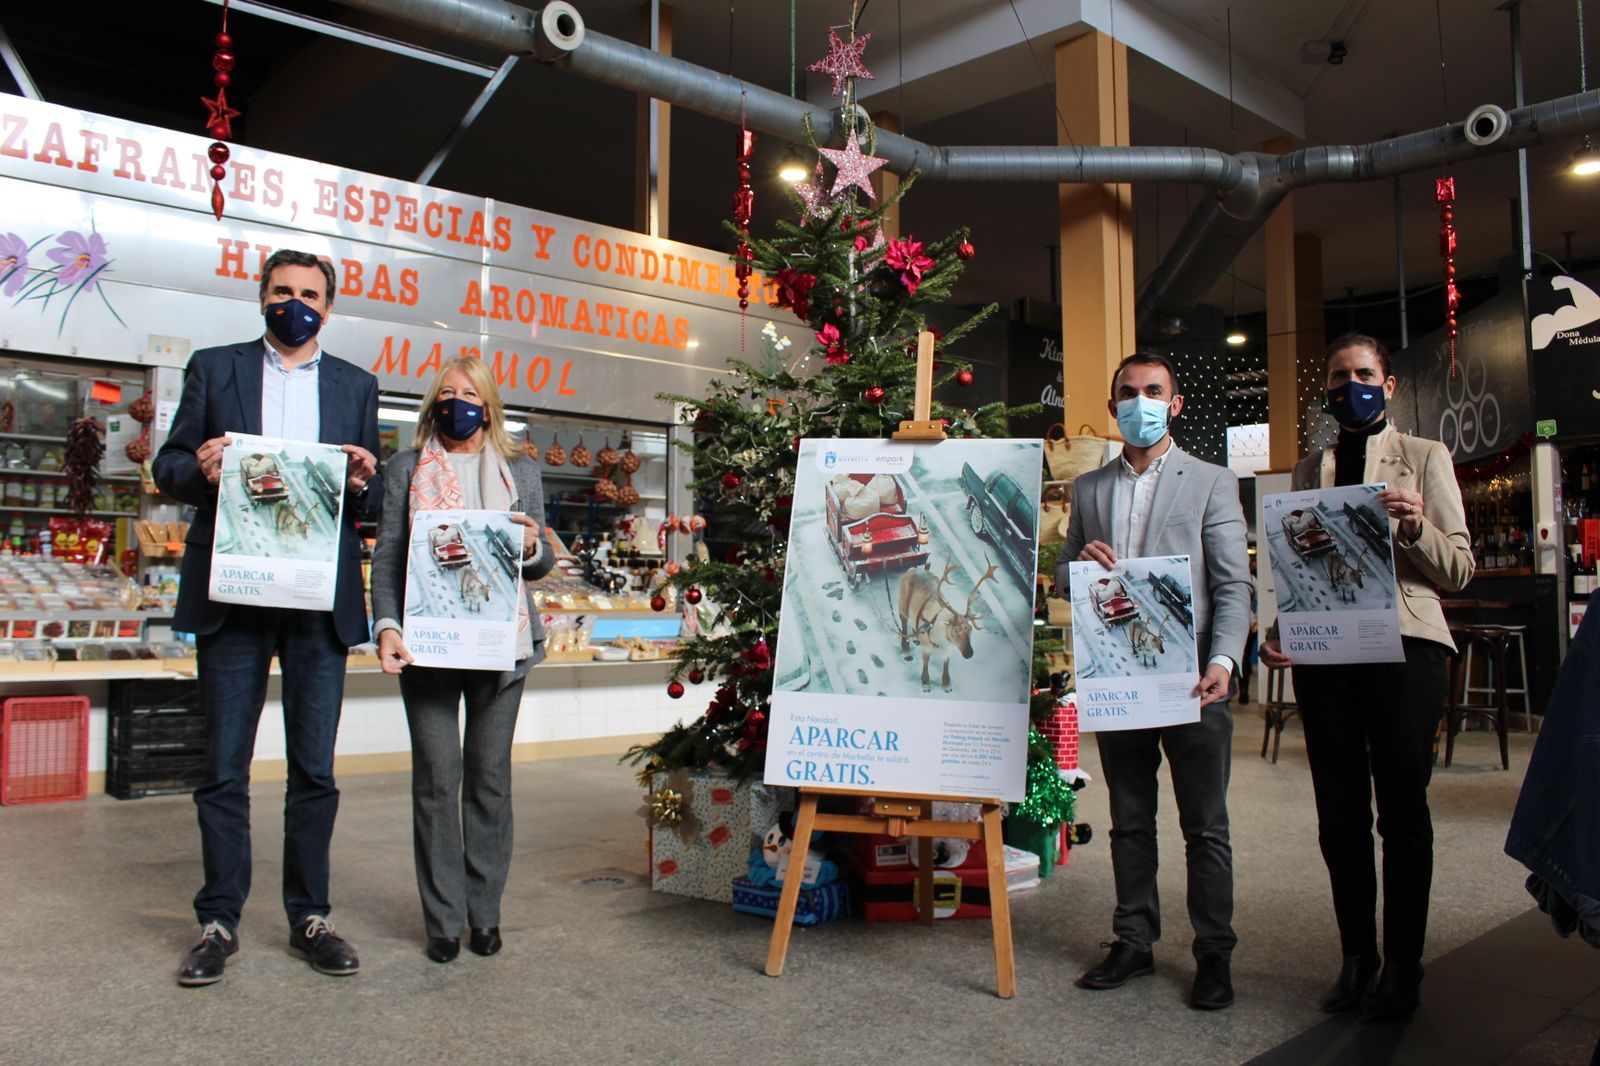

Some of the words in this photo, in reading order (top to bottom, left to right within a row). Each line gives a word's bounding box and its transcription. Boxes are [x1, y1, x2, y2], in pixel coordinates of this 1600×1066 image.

[313, 178, 512, 252] ESPECIAS
[531, 224, 556, 260] Y
[573, 234, 793, 311] CONDIMENTO
[215, 237, 420, 306] HIBAS
[460, 280, 690, 350] AROMATICAS
[1556, 331, 1580, 339] Dona
[875, 454, 904, 463] empark
[221, 568, 275, 582] APARCAR
[218, 584, 263, 596] GRATIS.
[412, 630, 460, 641] APARCAR
[1289, 625, 1339, 636] APARCAR
[410, 644, 449, 655] GRATIS.
[1290, 641, 1331, 652] GRATIS.
[1087, 690, 1139, 702] APARCAR
[1087, 706, 1130, 718] GRATIS.
[789, 725, 899, 752] APARCAR
[786, 759, 875, 785] GRATIS.
